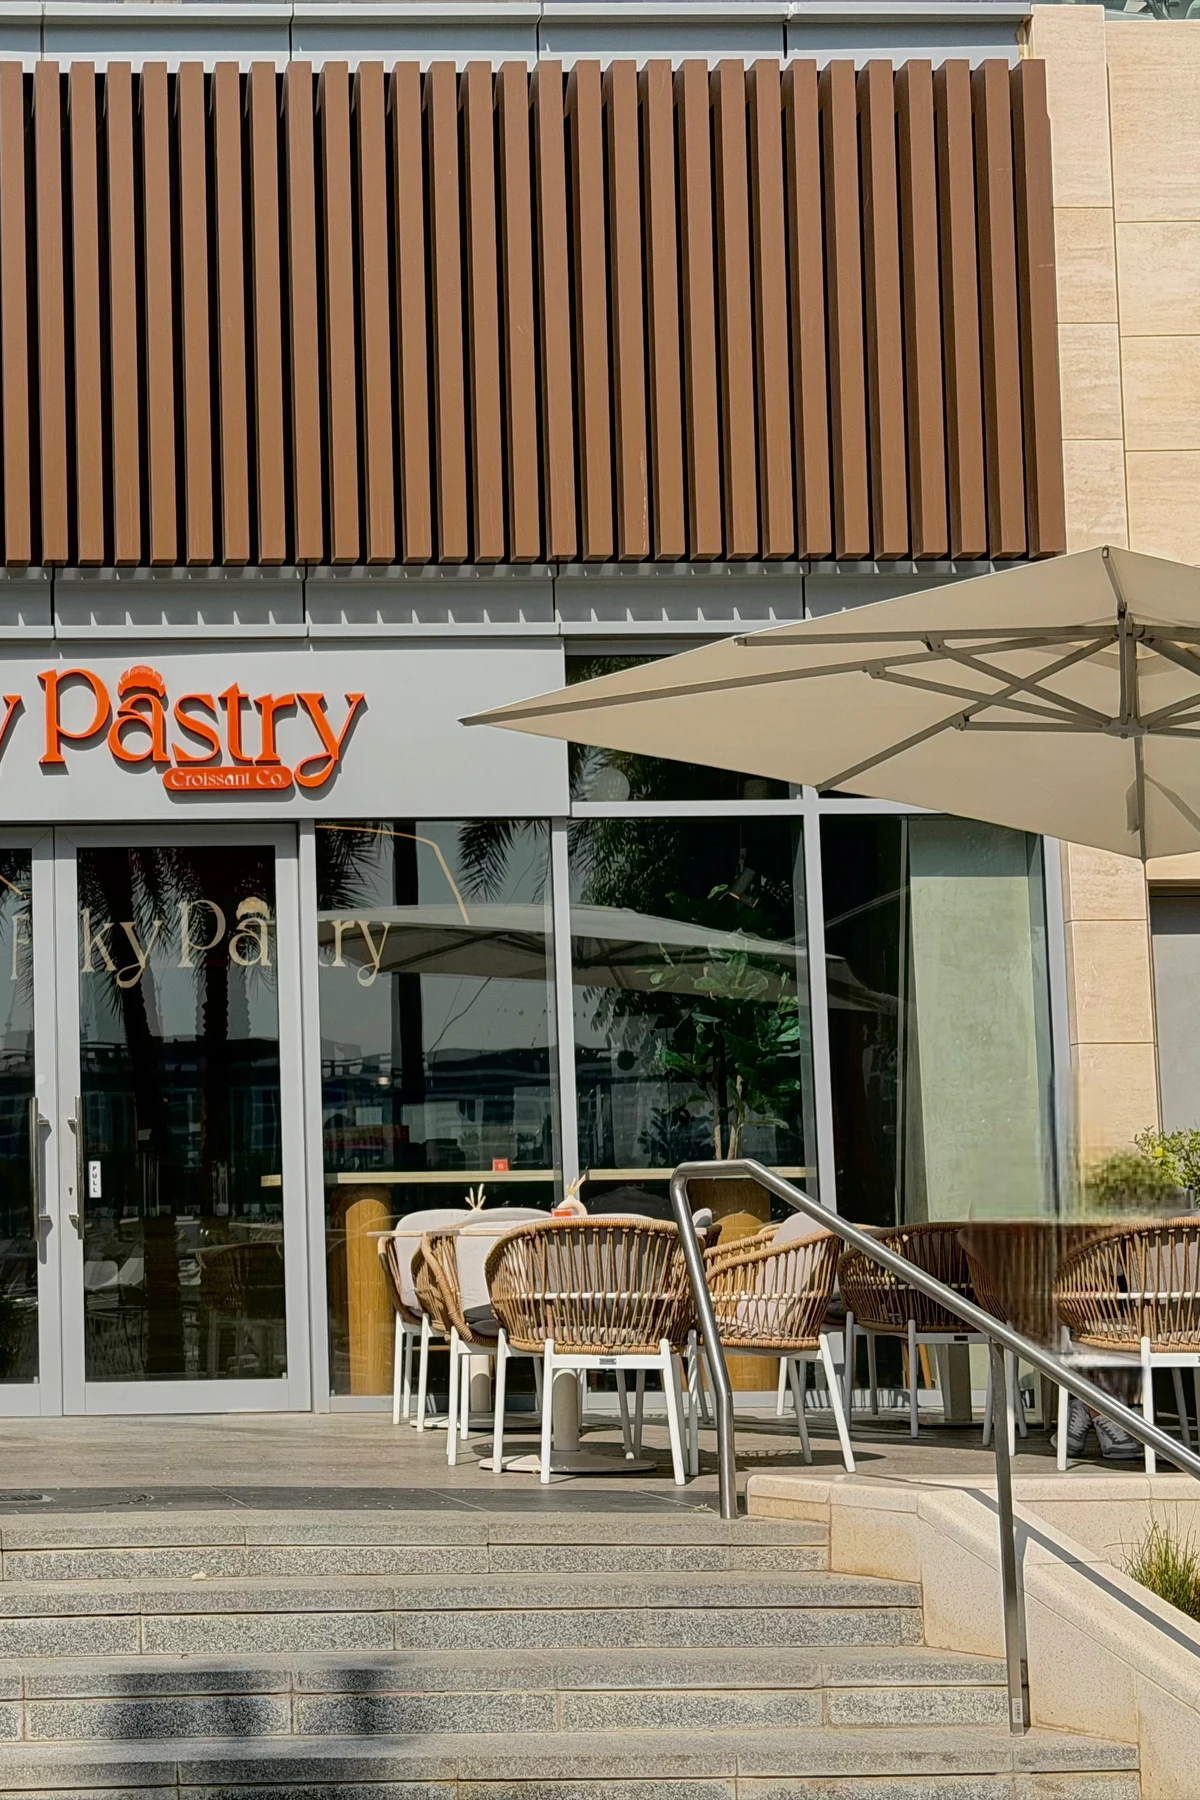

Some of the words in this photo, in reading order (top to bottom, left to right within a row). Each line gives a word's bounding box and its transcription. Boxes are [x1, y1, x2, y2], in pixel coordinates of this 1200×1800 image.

[37, 667, 366, 788] Pastry
[170, 771, 250, 786] Croissant
[256, 770, 285, 786] Co.
[10, 908, 163, 988] Fky
[177, 899, 392, 987] Pary
